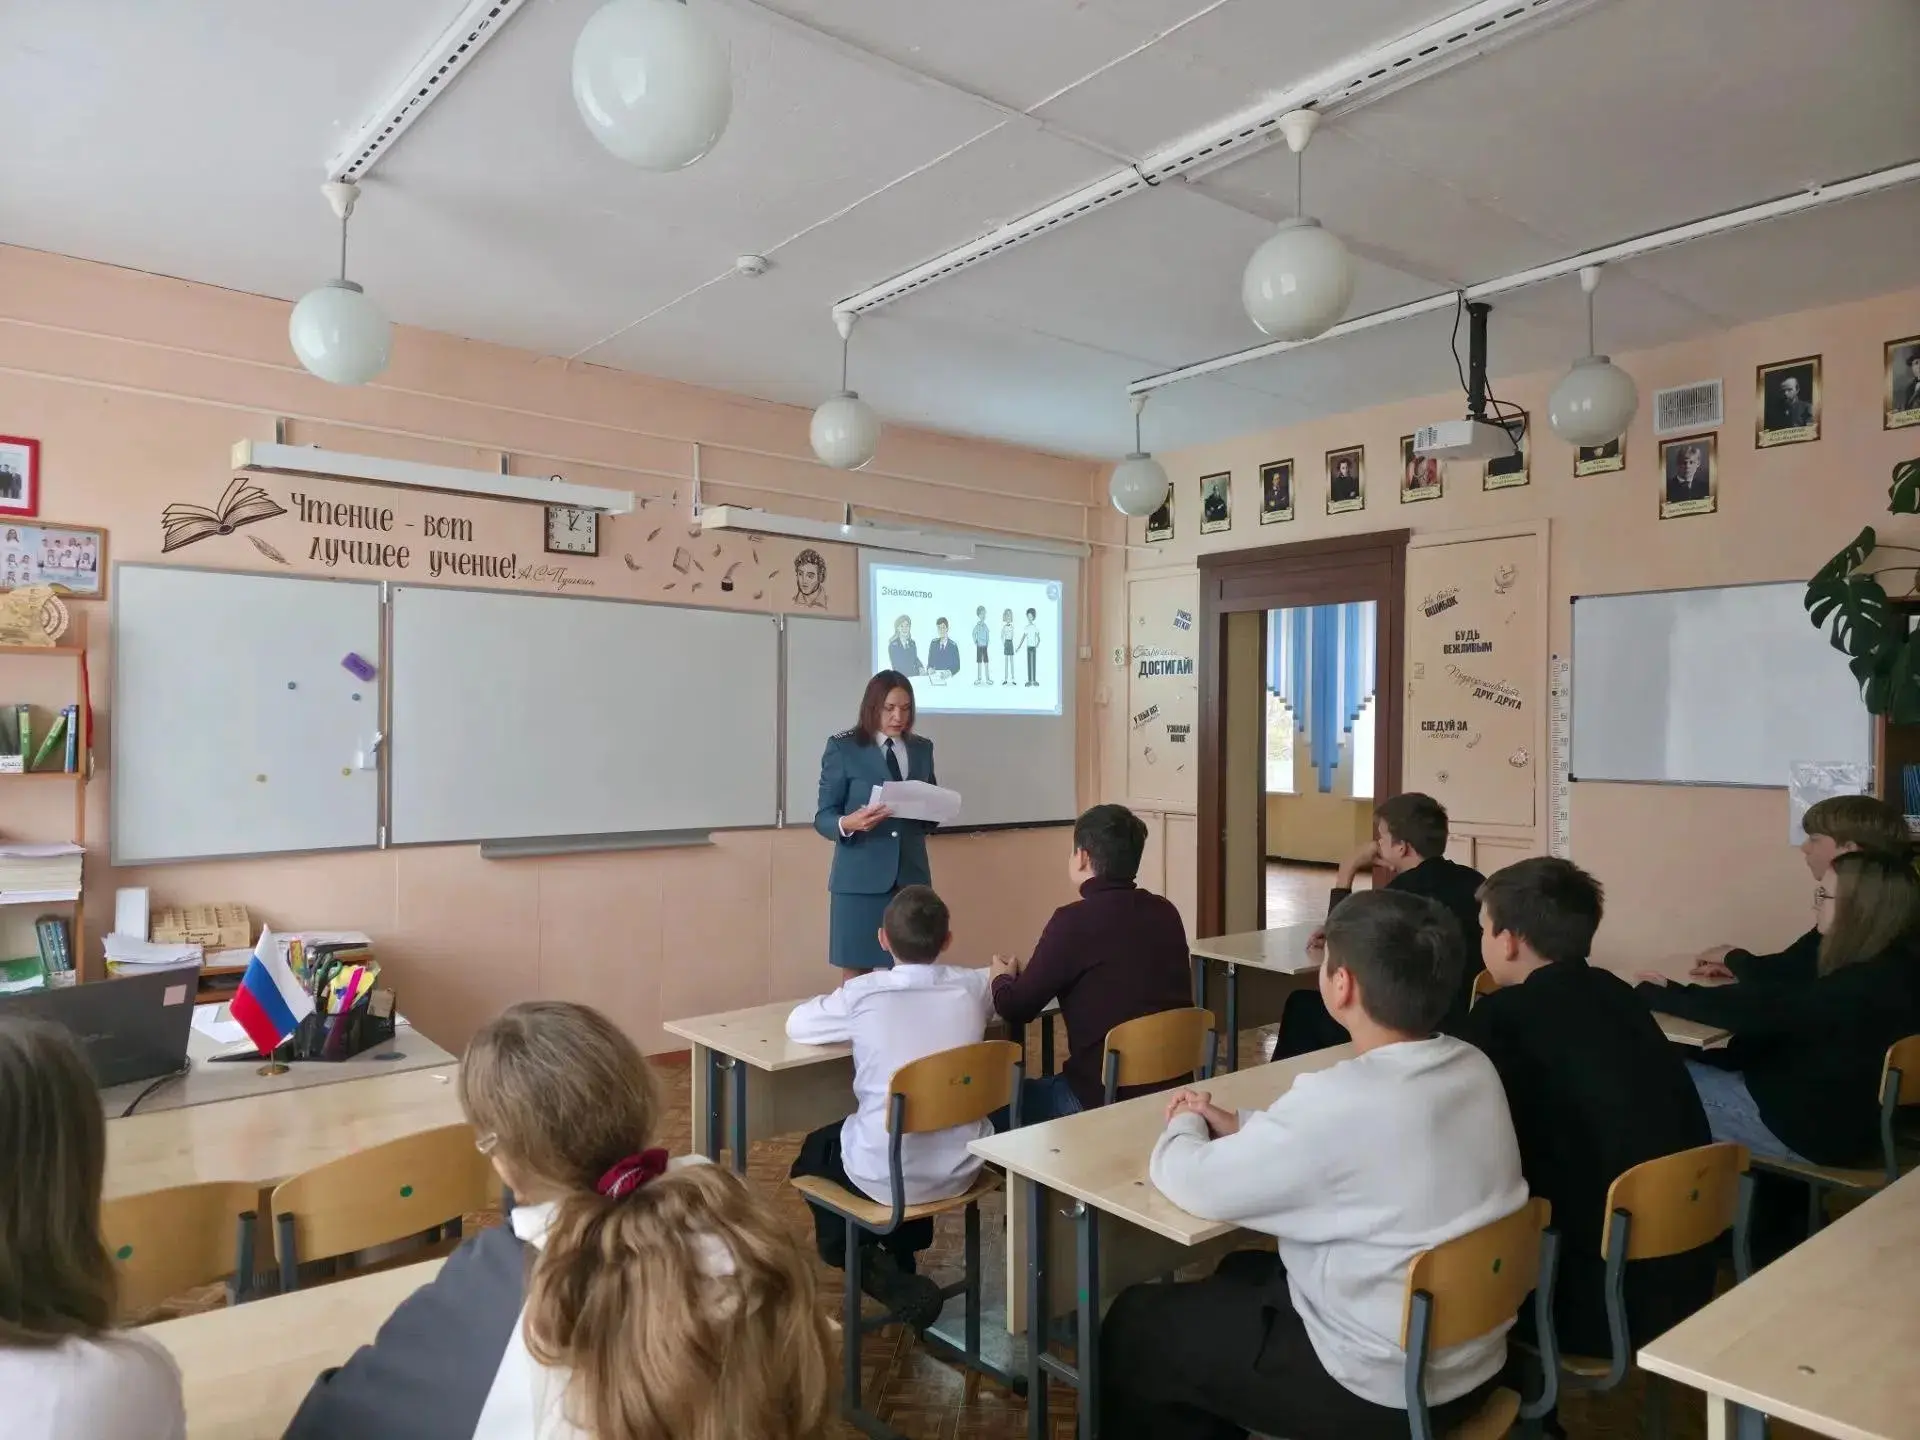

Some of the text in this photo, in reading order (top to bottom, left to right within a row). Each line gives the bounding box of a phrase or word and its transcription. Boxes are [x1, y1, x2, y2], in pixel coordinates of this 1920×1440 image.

[291, 492, 394, 531] Чтение
[424, 514, 474, 542] вот
[308, 536, 517, 580] лучшее учение!
[881, 586, 933, 599] Знакомство
[1425, 595, 1459, 618] ОШИБОК
[1455, 630, 1480, 642] БУДЬ
[1443, 642, 1493, 655] ВЕЖЛИВЫМ
[1138, 656, 1193, 678] ДОСТИГАЙ!
[1472, 687, 1523, 711] ДРУГ ДРУГА
[1421, 719, 1468, 733] СЛЕДУЙ ЗА
